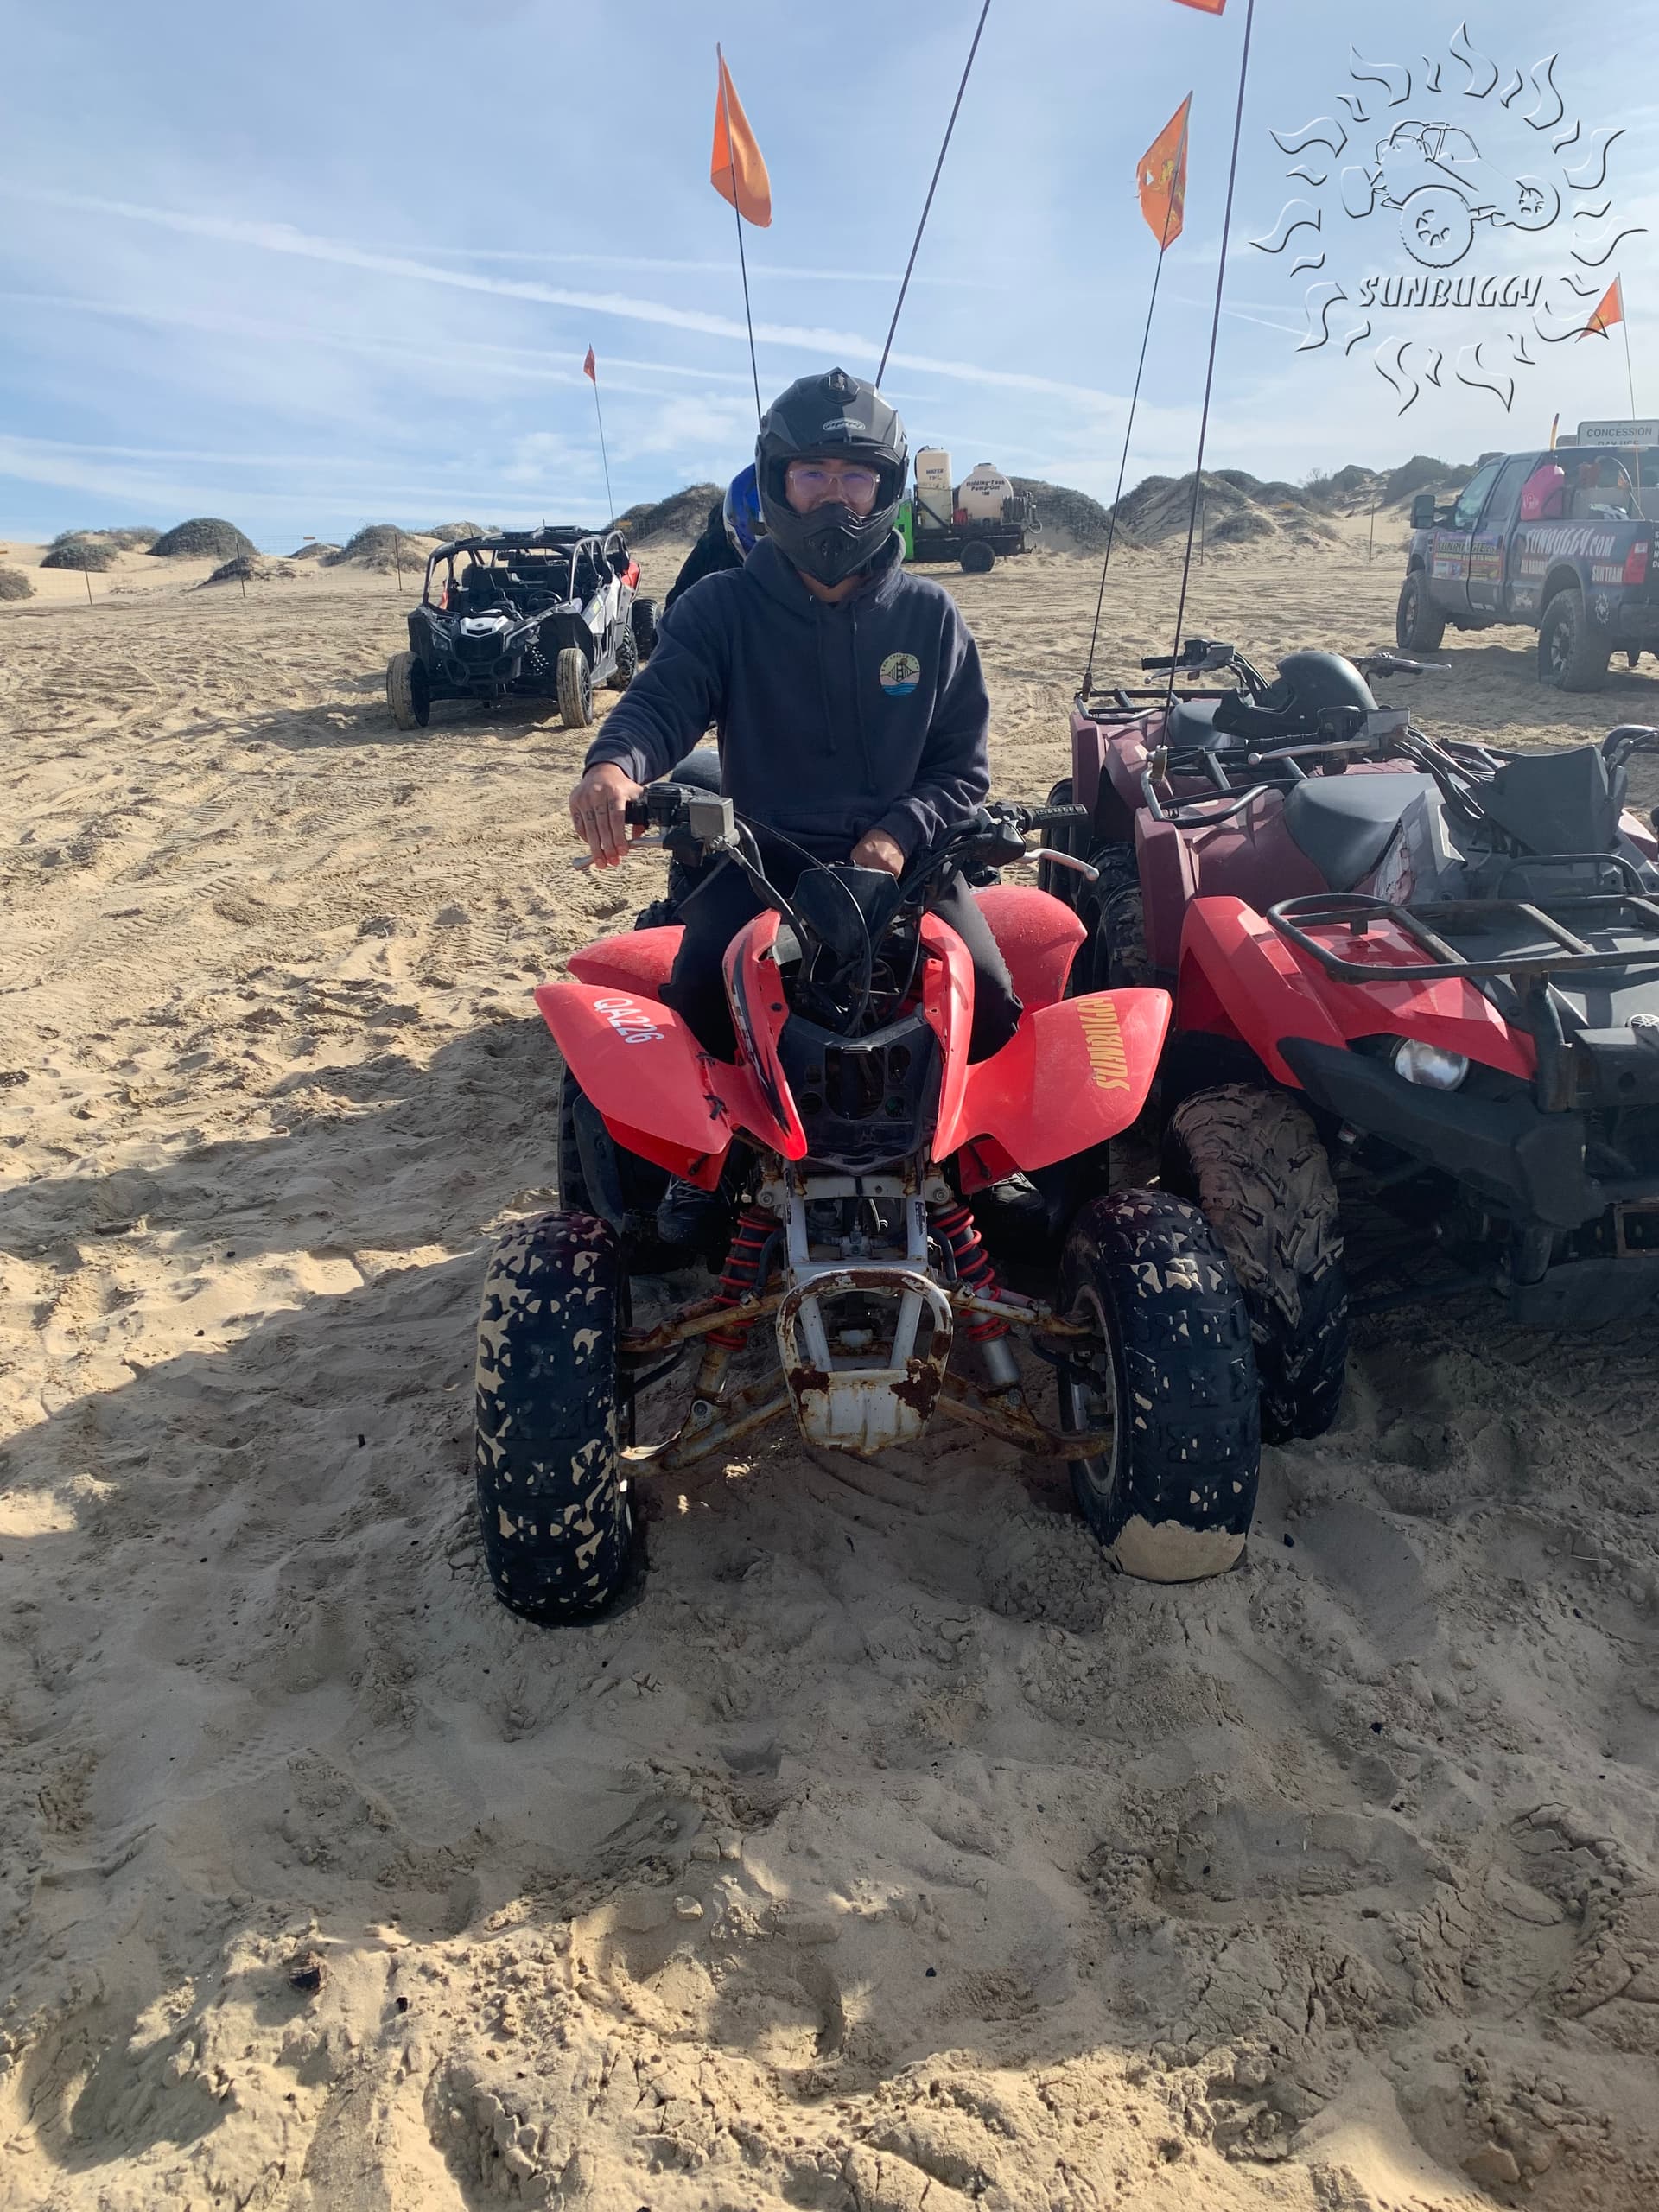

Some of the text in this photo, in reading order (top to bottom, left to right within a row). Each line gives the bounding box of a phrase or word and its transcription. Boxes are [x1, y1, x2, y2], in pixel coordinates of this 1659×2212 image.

[1586, 427, 1652, 437] CONCESSION
[1524, 527, 1616, 557] SUNBUGGY.COM
[593, 997, 664, 1044] QA226
[1074, 996, 1131, 1092] SUNBUGGY
